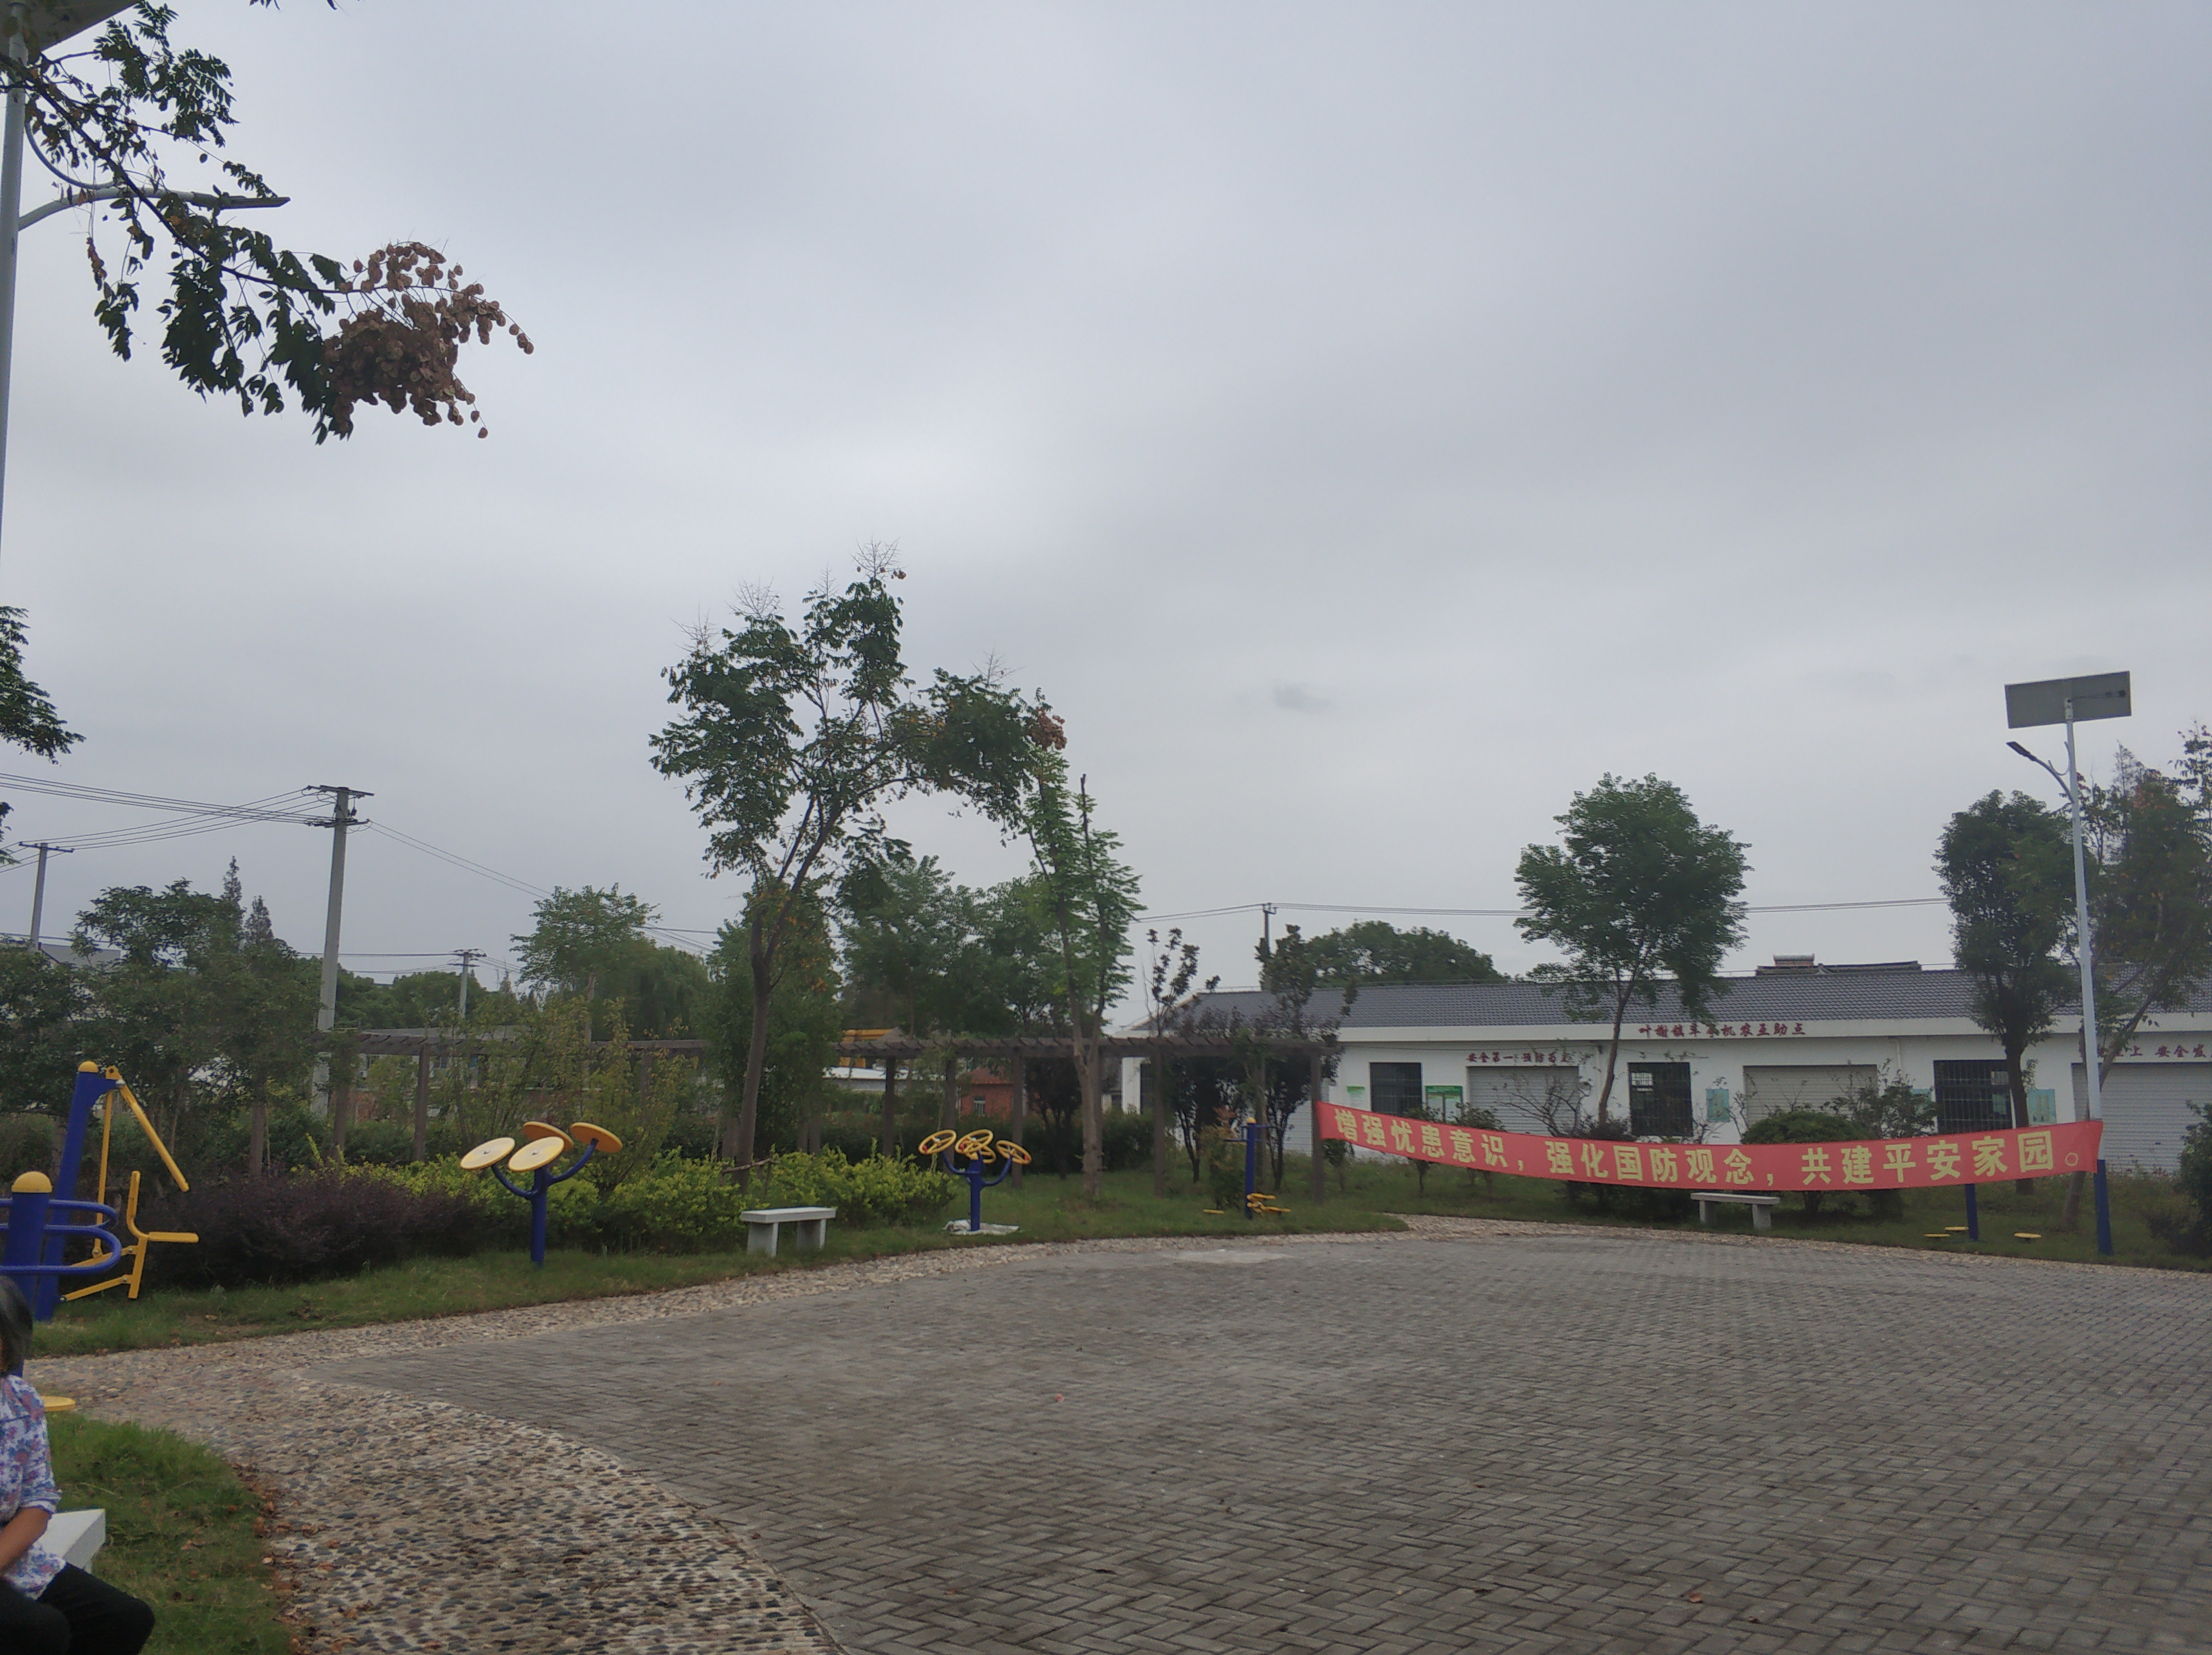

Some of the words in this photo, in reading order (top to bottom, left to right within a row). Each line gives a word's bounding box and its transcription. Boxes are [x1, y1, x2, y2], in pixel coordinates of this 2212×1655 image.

[1466, 1051, 1514, 1063] 安全第一
[2155, 1044, 2212, 1058] 安全发
